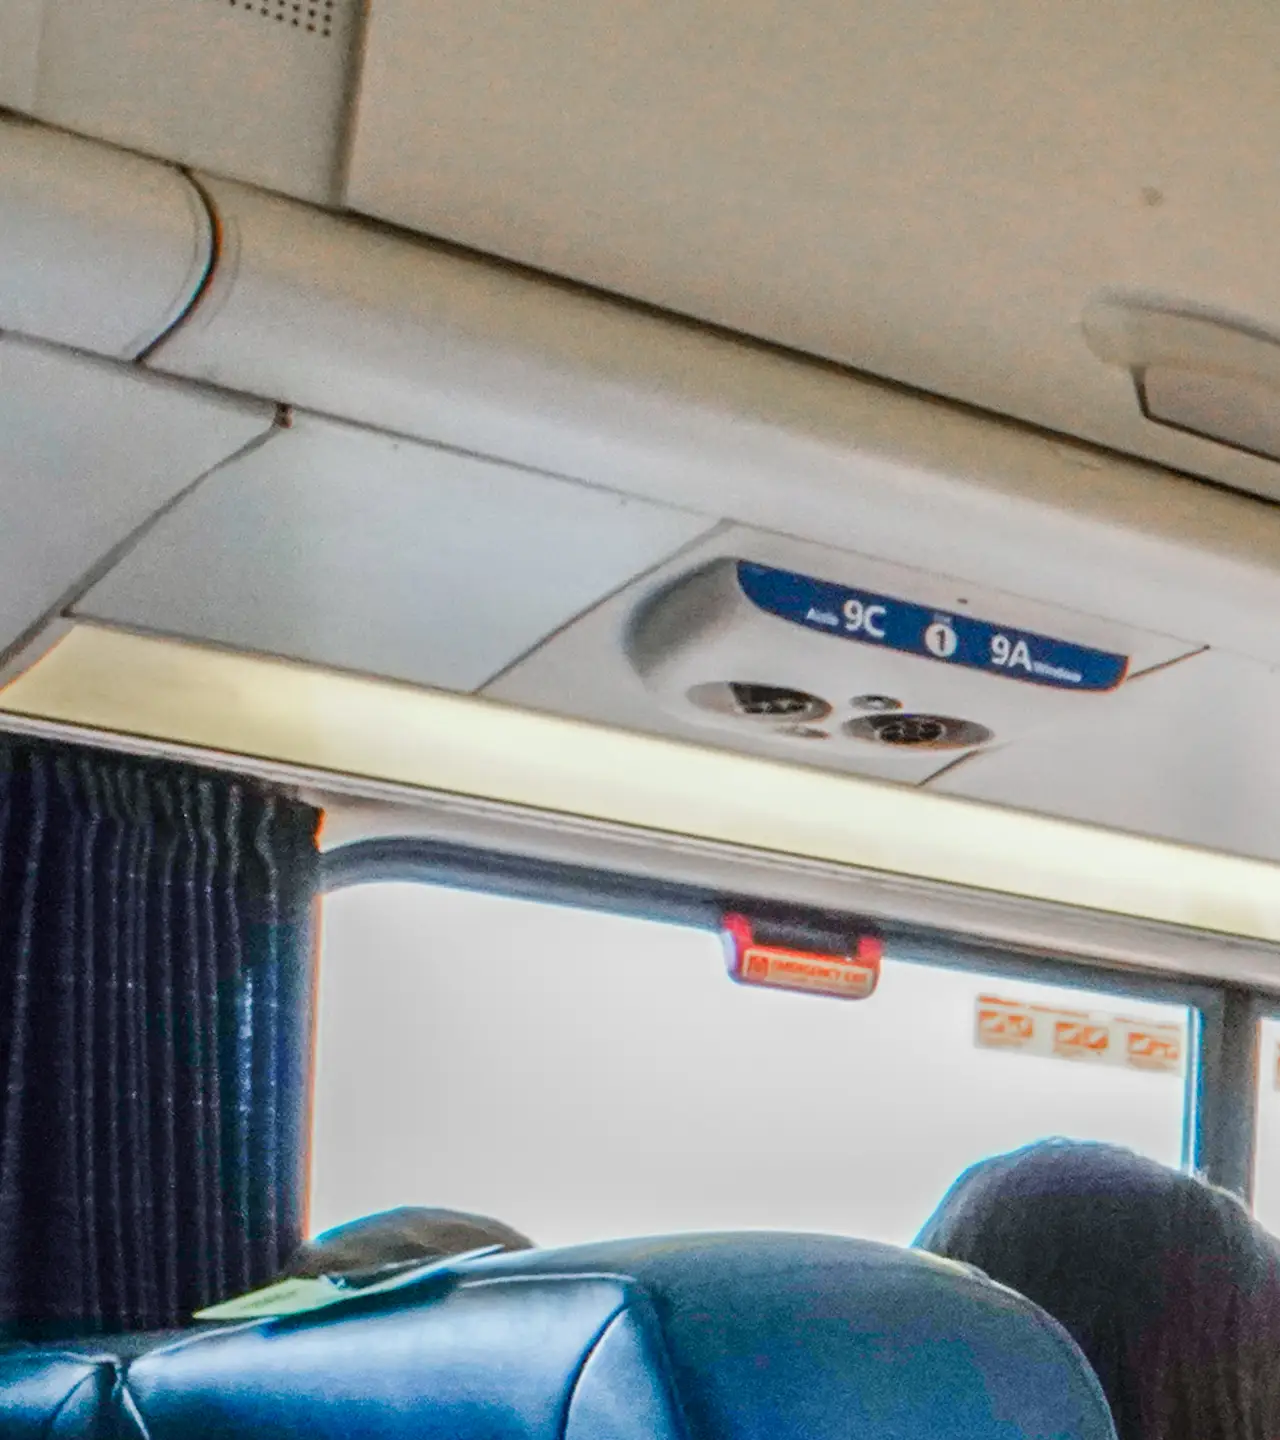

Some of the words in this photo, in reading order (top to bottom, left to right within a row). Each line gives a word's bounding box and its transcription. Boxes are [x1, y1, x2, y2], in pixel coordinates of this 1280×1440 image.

[844, 599, 886, 638] 9C
[936, 628, 947, 651] 1
[991, 633, 1032, 672] 9A
